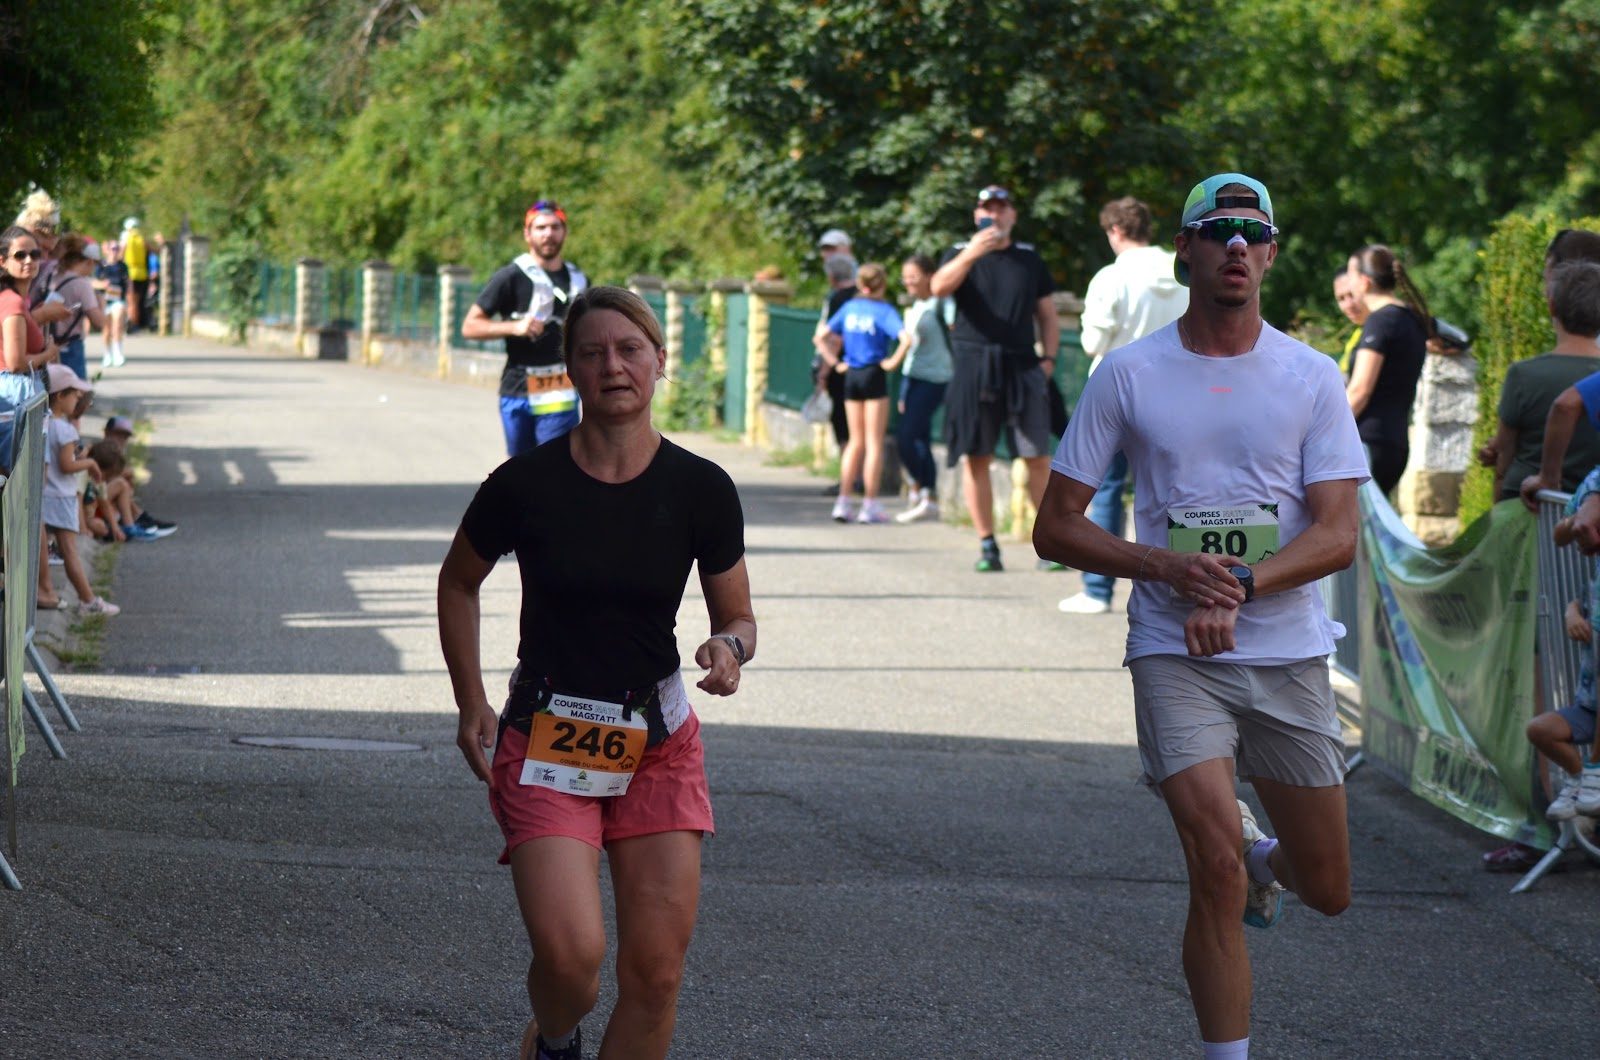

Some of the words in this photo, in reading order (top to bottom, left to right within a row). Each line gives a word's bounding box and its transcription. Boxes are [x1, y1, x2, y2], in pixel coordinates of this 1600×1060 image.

[1184, 510, 1221, 519] COURSES
[1222, 509, 1256, 517] NATURE
[1200, 517, 1245, 526] MAGSTATT
[1200, 529, 1248, 558] 80
[554, 698, 593, 711] COURSES
[570, 709, 617, 724] MAGSTATT
[550, 721, 627, 760] 246
